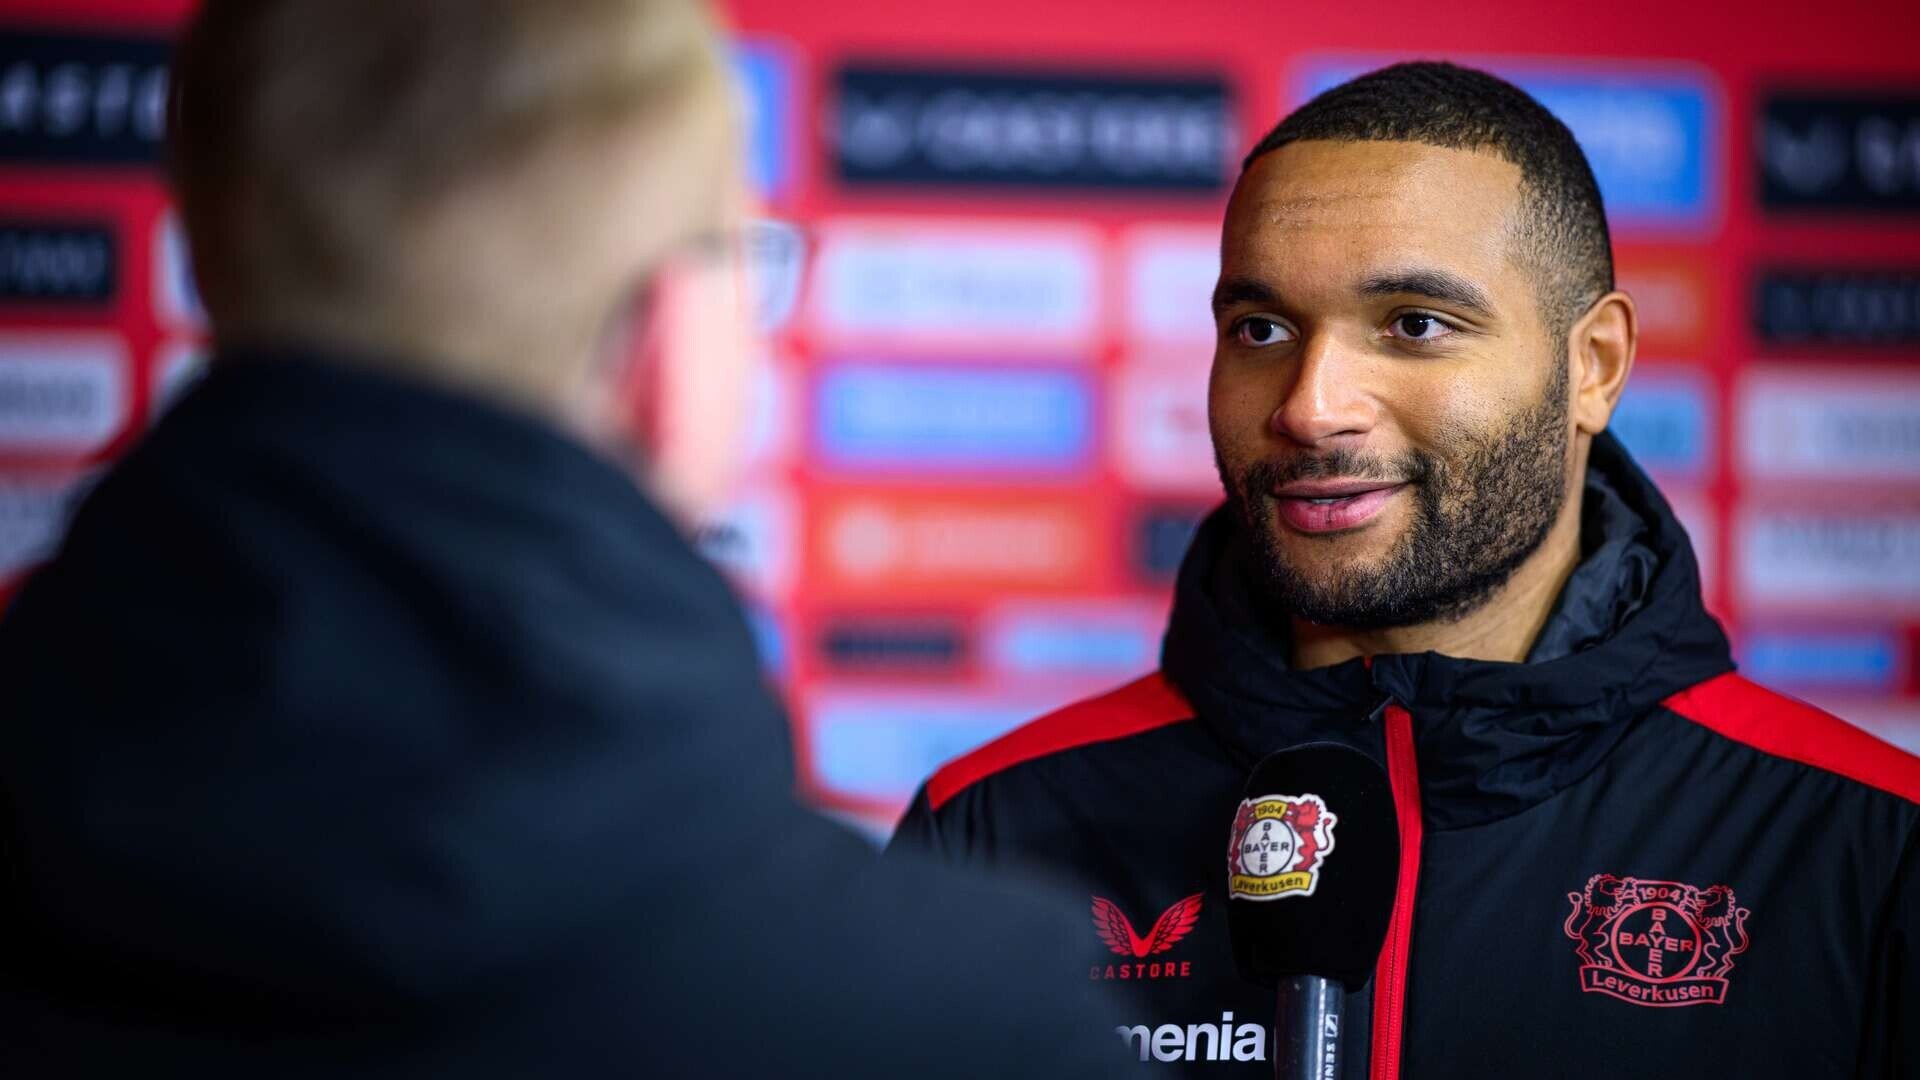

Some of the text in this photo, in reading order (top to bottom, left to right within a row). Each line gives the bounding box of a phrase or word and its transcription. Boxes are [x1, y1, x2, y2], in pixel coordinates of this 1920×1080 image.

[1257, 804, 1283, 815] 1904
[1244, 841, 1290, 854] BAYER
[1259, 821, 1272, 873] BAYER
[1233, 876, 1304, 893] Leverkusen
[1638, 886, 1681, 901] 1904
[1618, 932, 1694, 952] BAYER
[1647, 907, 1667, 978] BAYER
[1089, 961, 1191, 980] CASTORE
[1592, 969, 1714, 1001] Leverkusen
[1325, 1042, 1336, 1080] SEN
